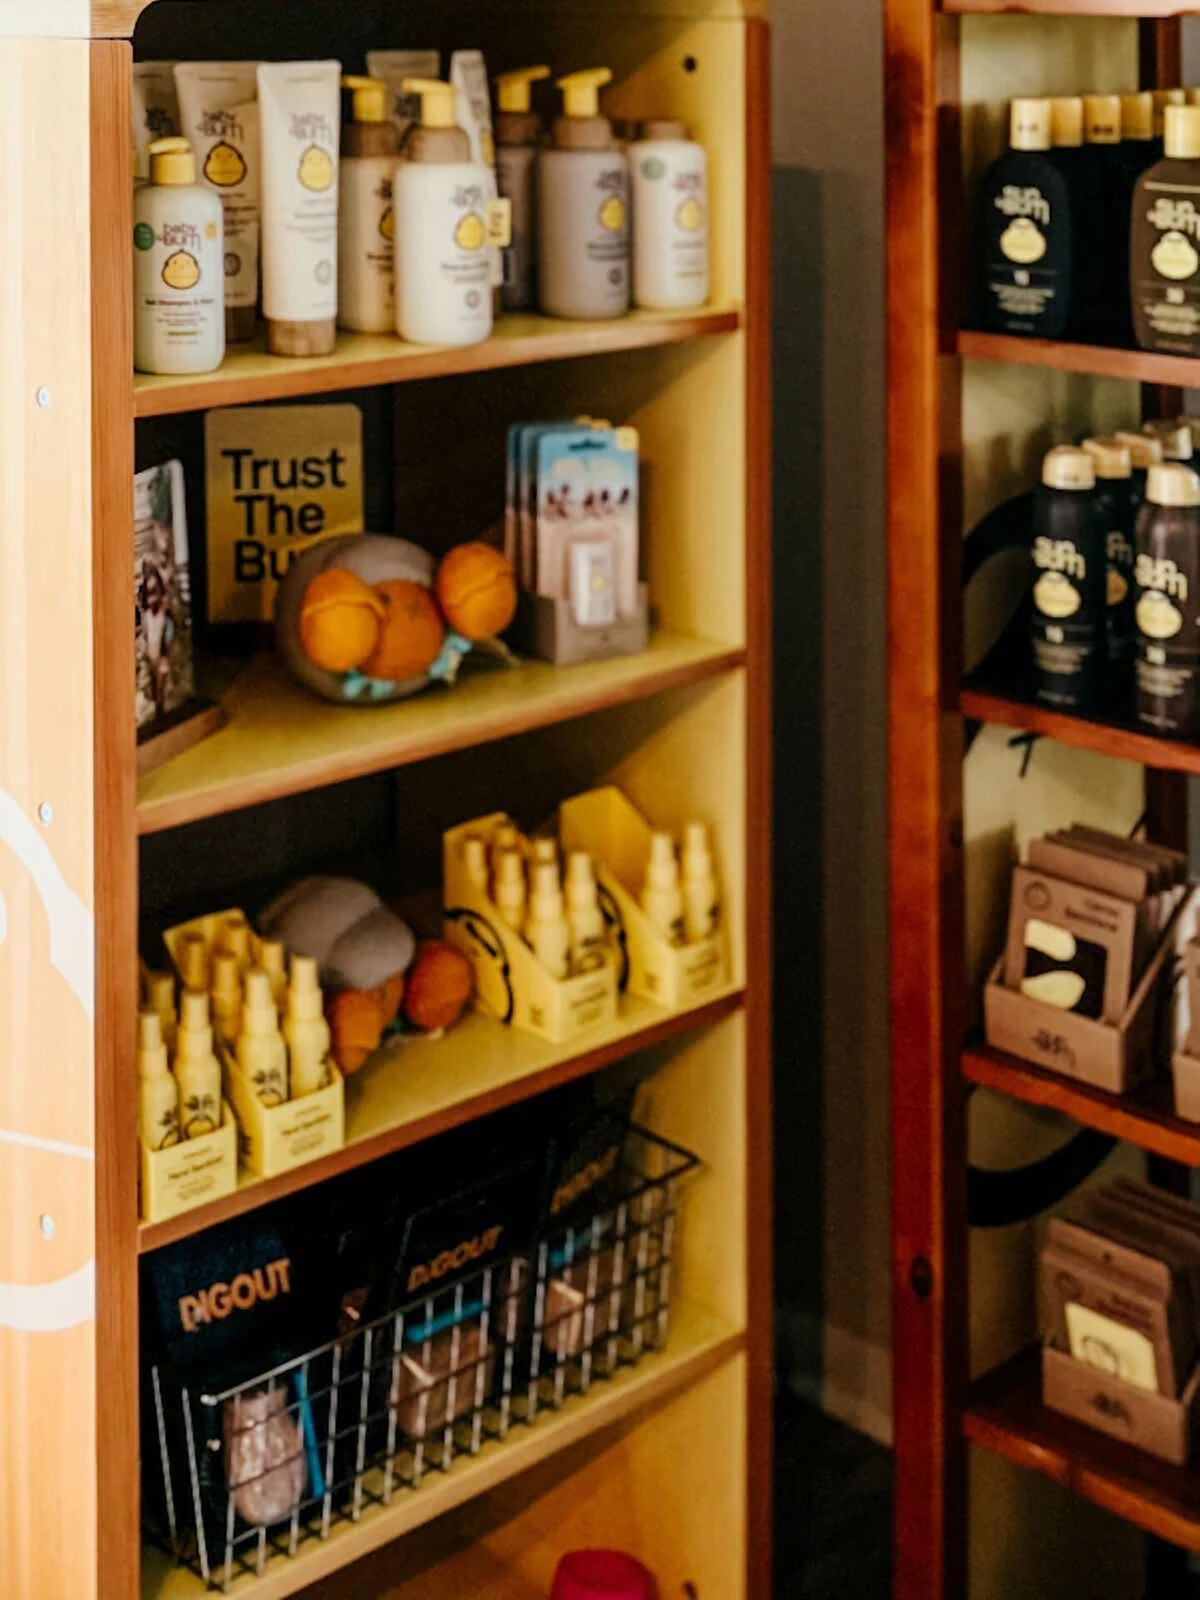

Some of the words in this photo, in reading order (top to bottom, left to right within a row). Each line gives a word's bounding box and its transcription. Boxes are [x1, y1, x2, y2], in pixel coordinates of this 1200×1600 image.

[220, 448, 347, 490] Trust
[234, 494, 325, 536] The
[234, 538, 296, 583] Bu
[178, 1257, 292, 1333] DIGOUT
